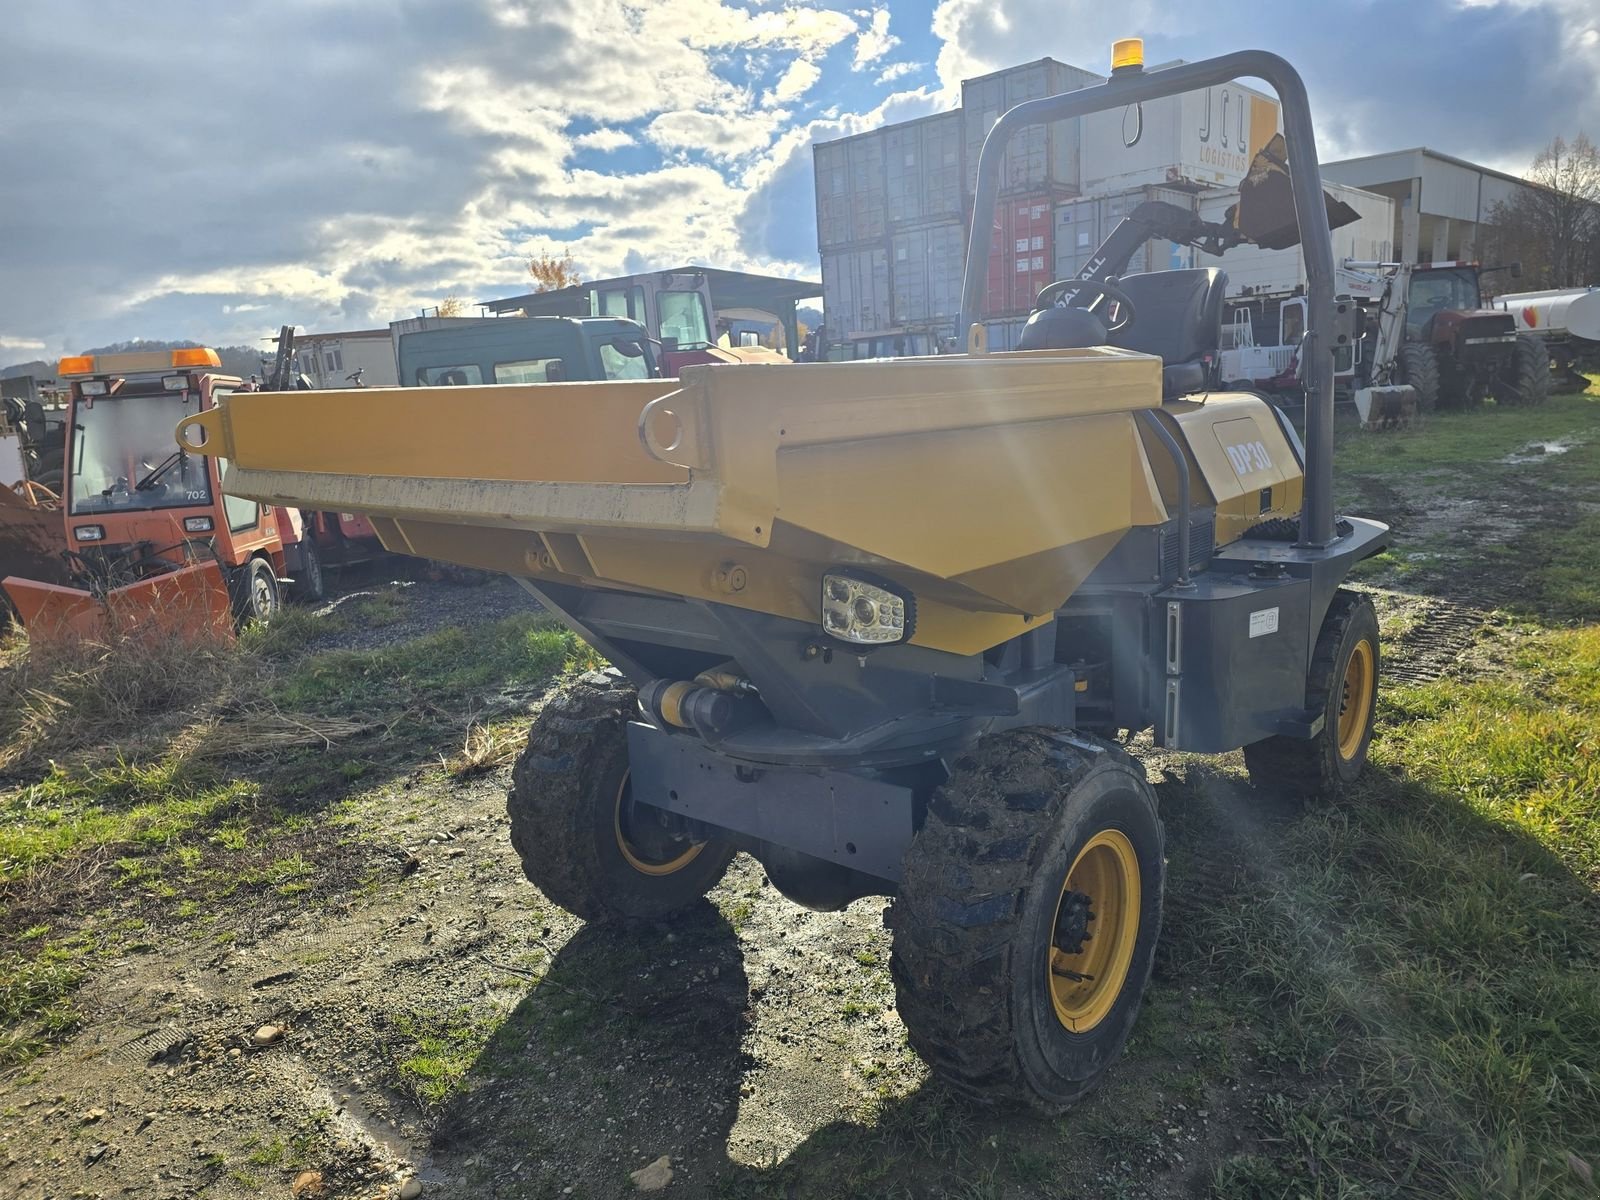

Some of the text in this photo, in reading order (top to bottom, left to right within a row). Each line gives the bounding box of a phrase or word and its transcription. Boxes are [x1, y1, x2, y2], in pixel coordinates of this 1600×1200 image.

[1199, 146, 1246, 173] LOGISTICS
[1226, 441, 1273, 475] DP30
[185, 489, 207, 501] 702
